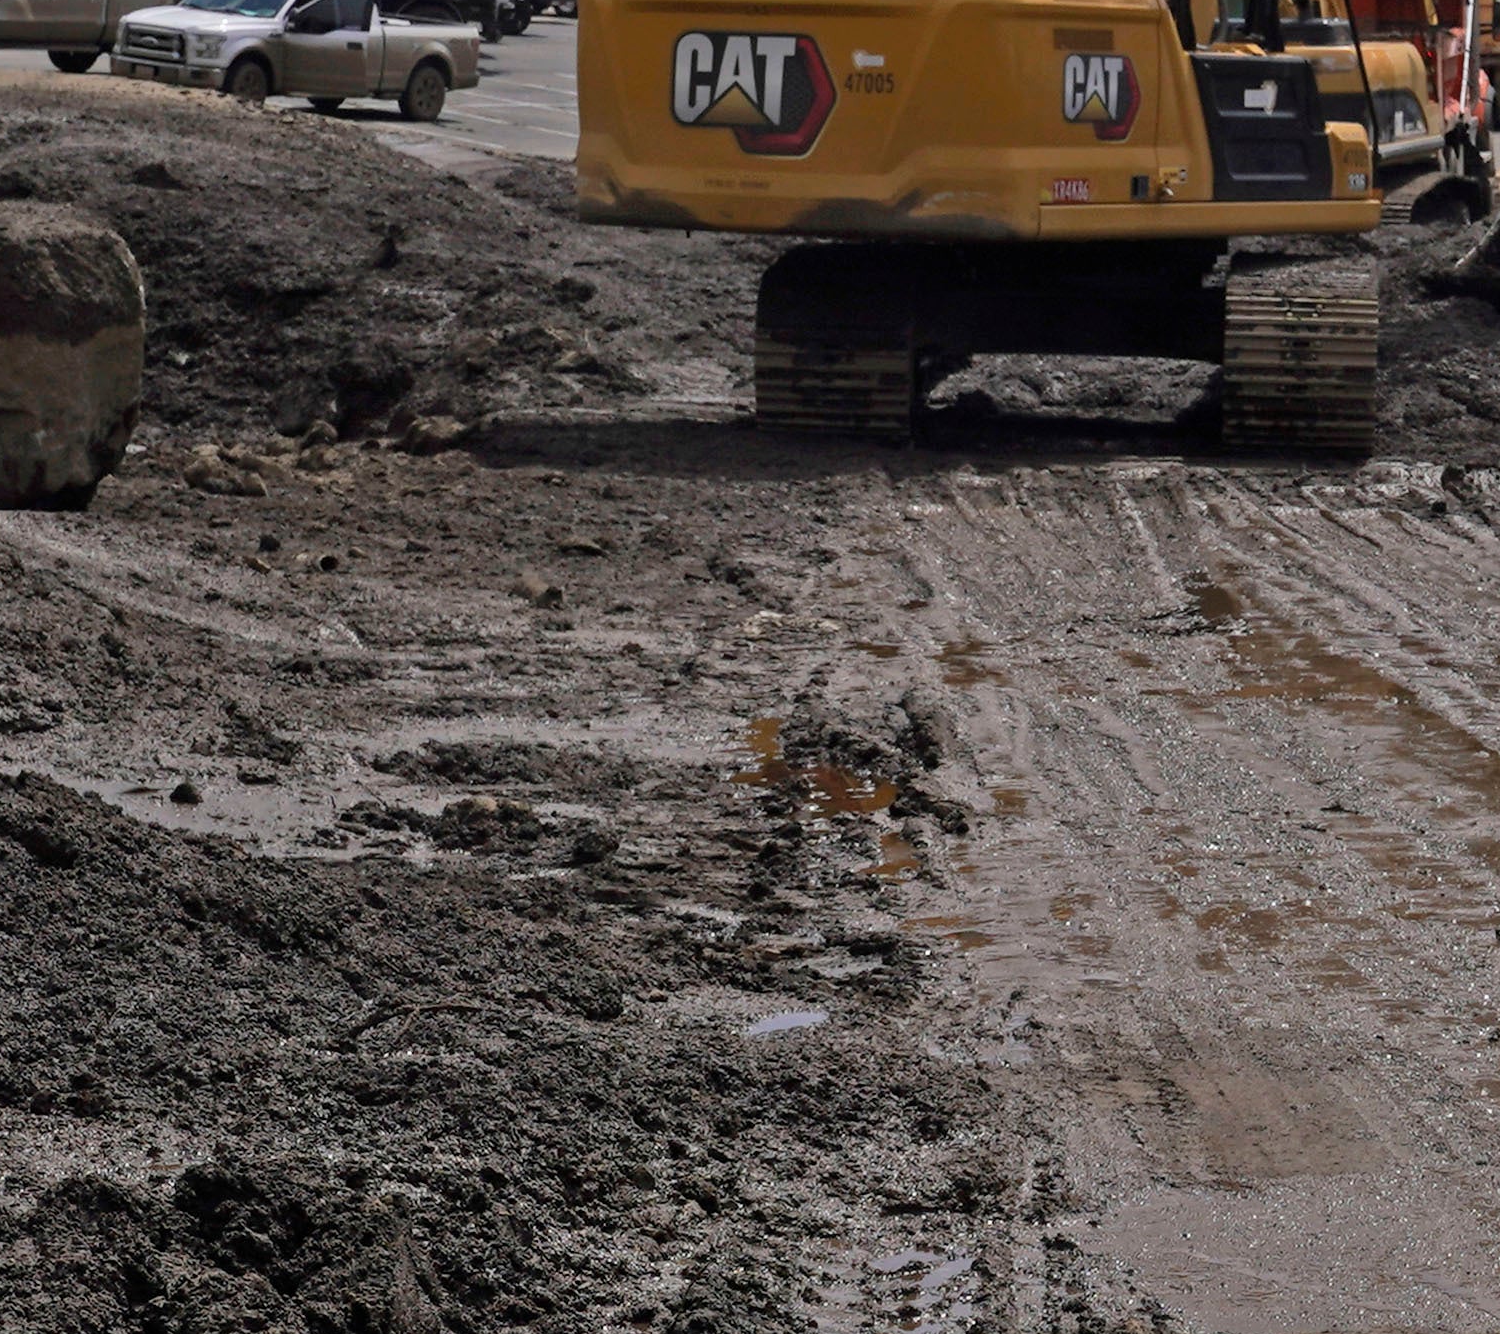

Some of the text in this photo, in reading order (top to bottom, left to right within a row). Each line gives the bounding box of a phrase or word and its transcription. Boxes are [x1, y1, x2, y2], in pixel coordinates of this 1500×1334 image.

[673, 32, 797, 126] CAT
[844, 72, 895, 94] 47005
[1064, 55, 1124, 121] CAT
